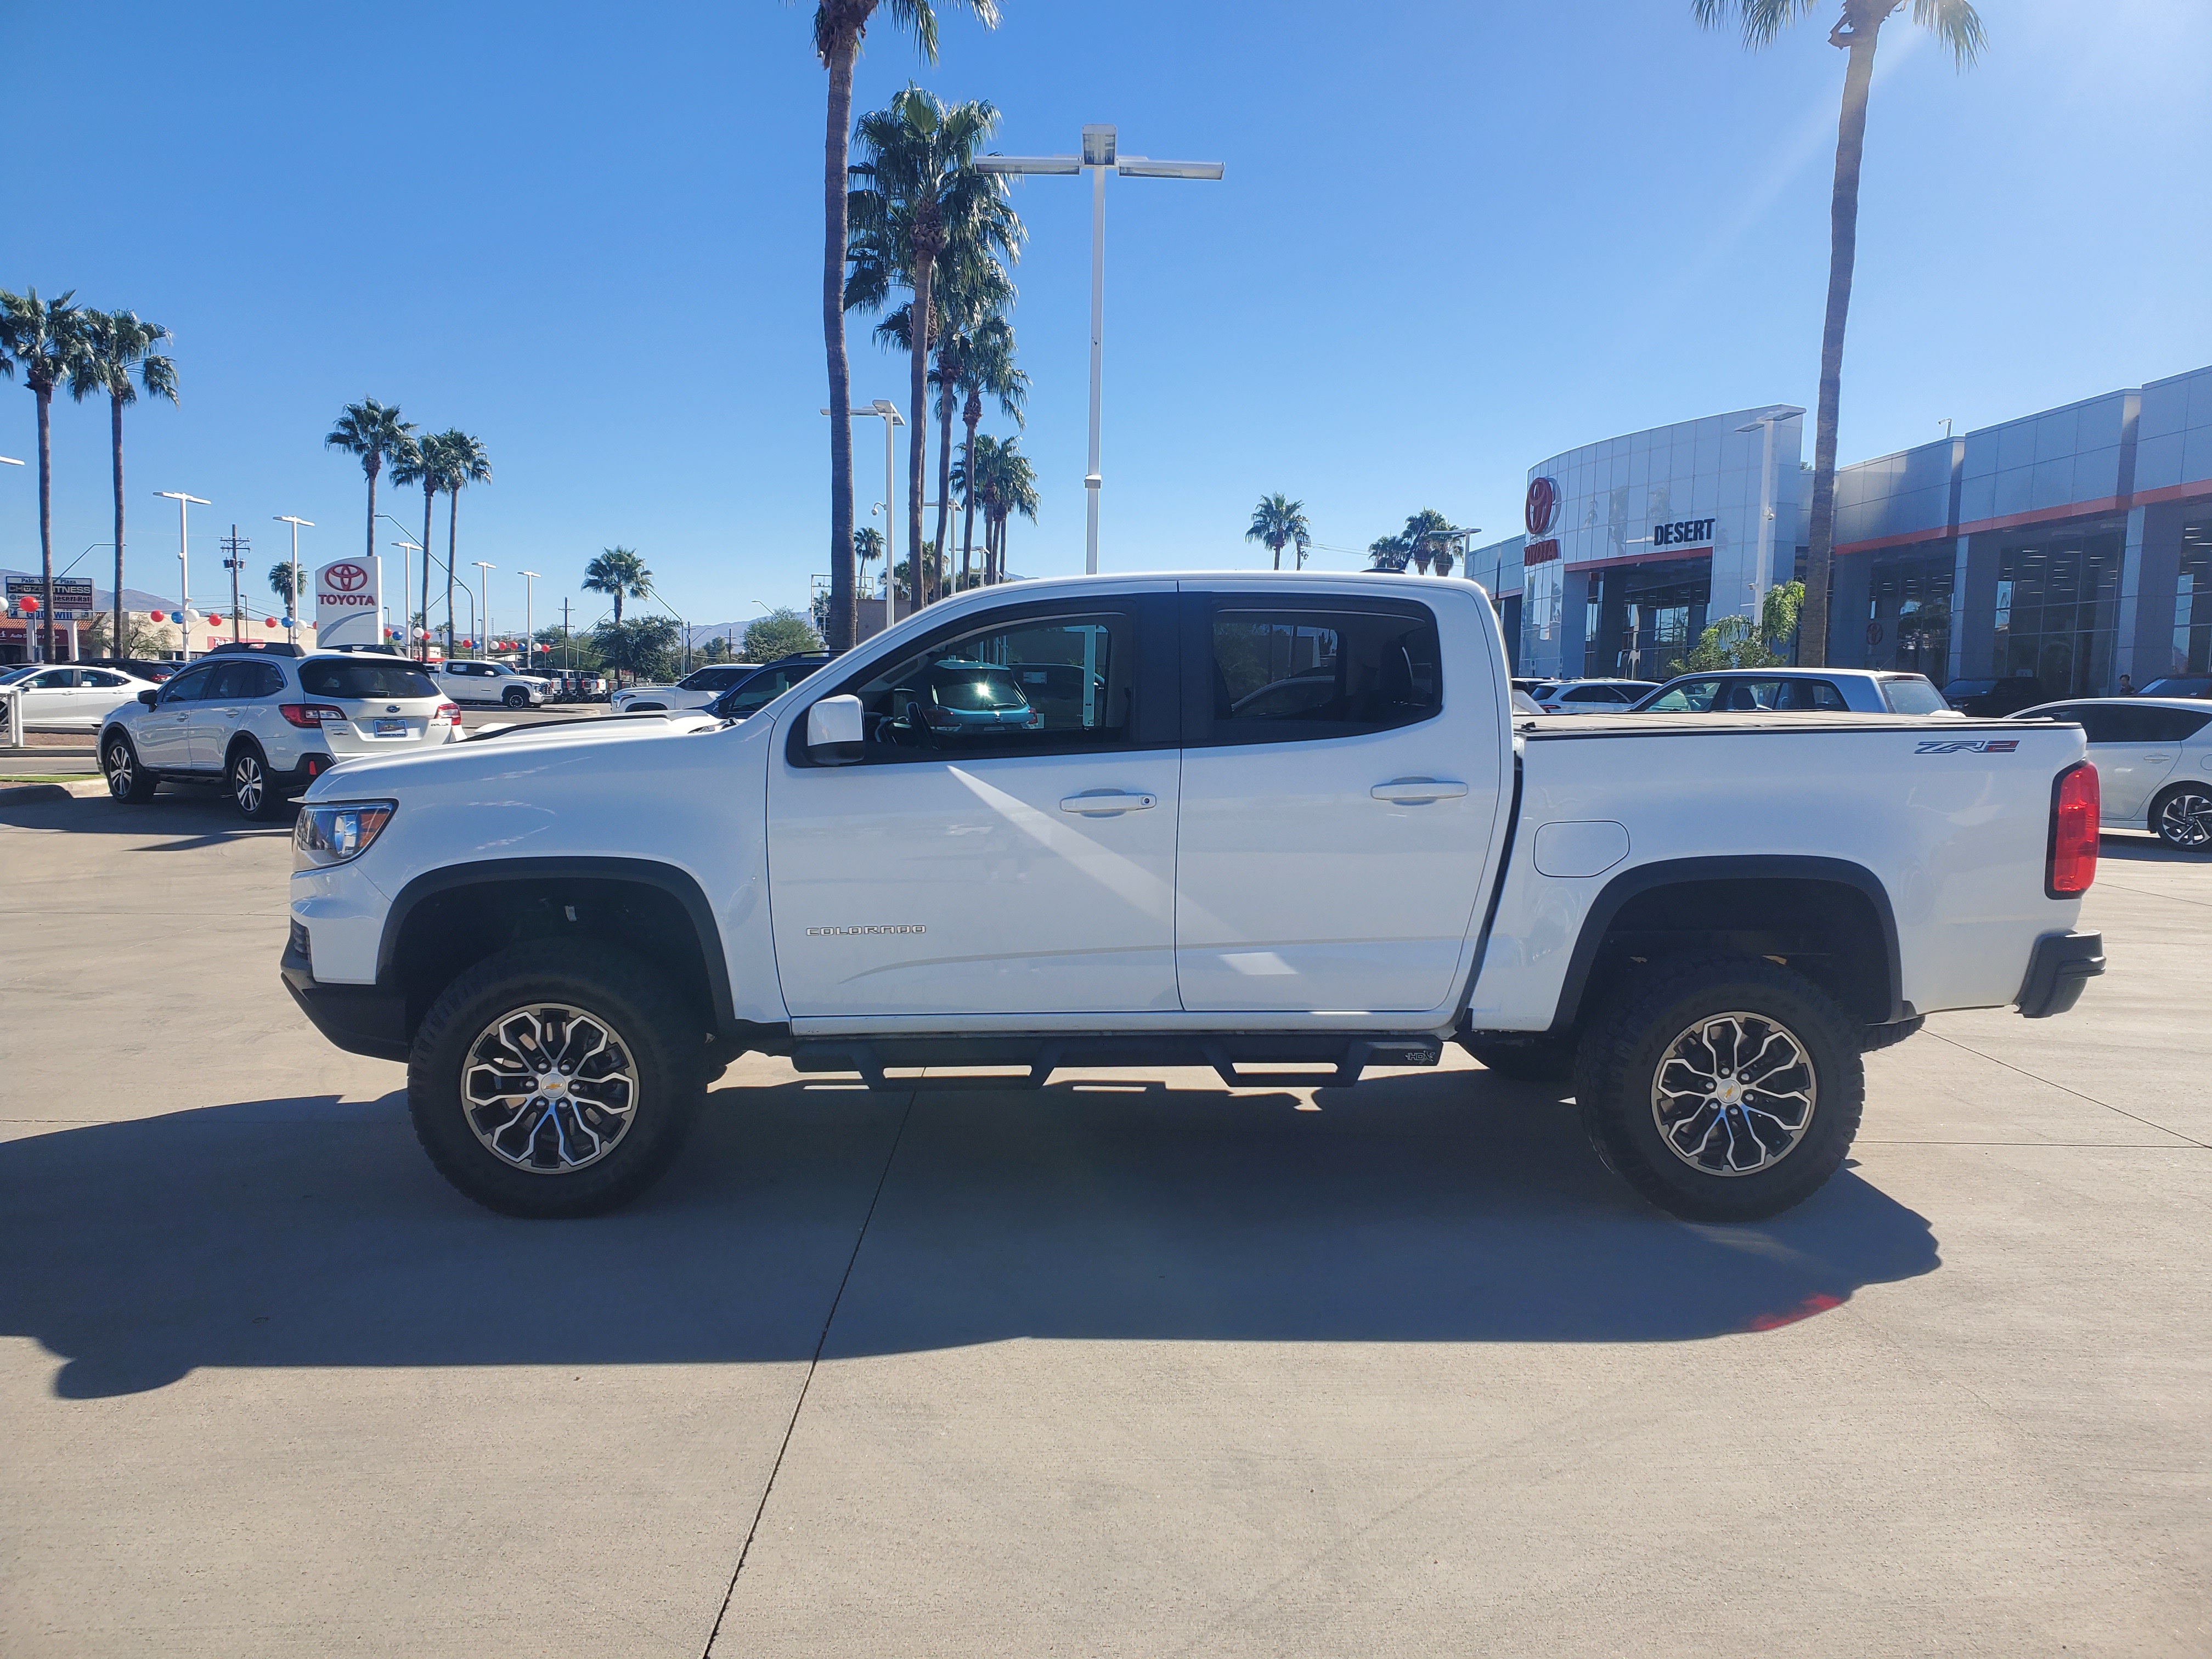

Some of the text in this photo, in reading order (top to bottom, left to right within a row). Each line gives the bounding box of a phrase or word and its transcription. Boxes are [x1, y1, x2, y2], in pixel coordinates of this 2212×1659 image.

[1654, 518, 1716, 546] DESERT
[1524, 539, 1560, 567] TOYOTA
[318, 594, 376, 606] TOYOTA
[1914, 740, 2020, 754] ZR2
[806, 925, 926, 936] COLORADO
